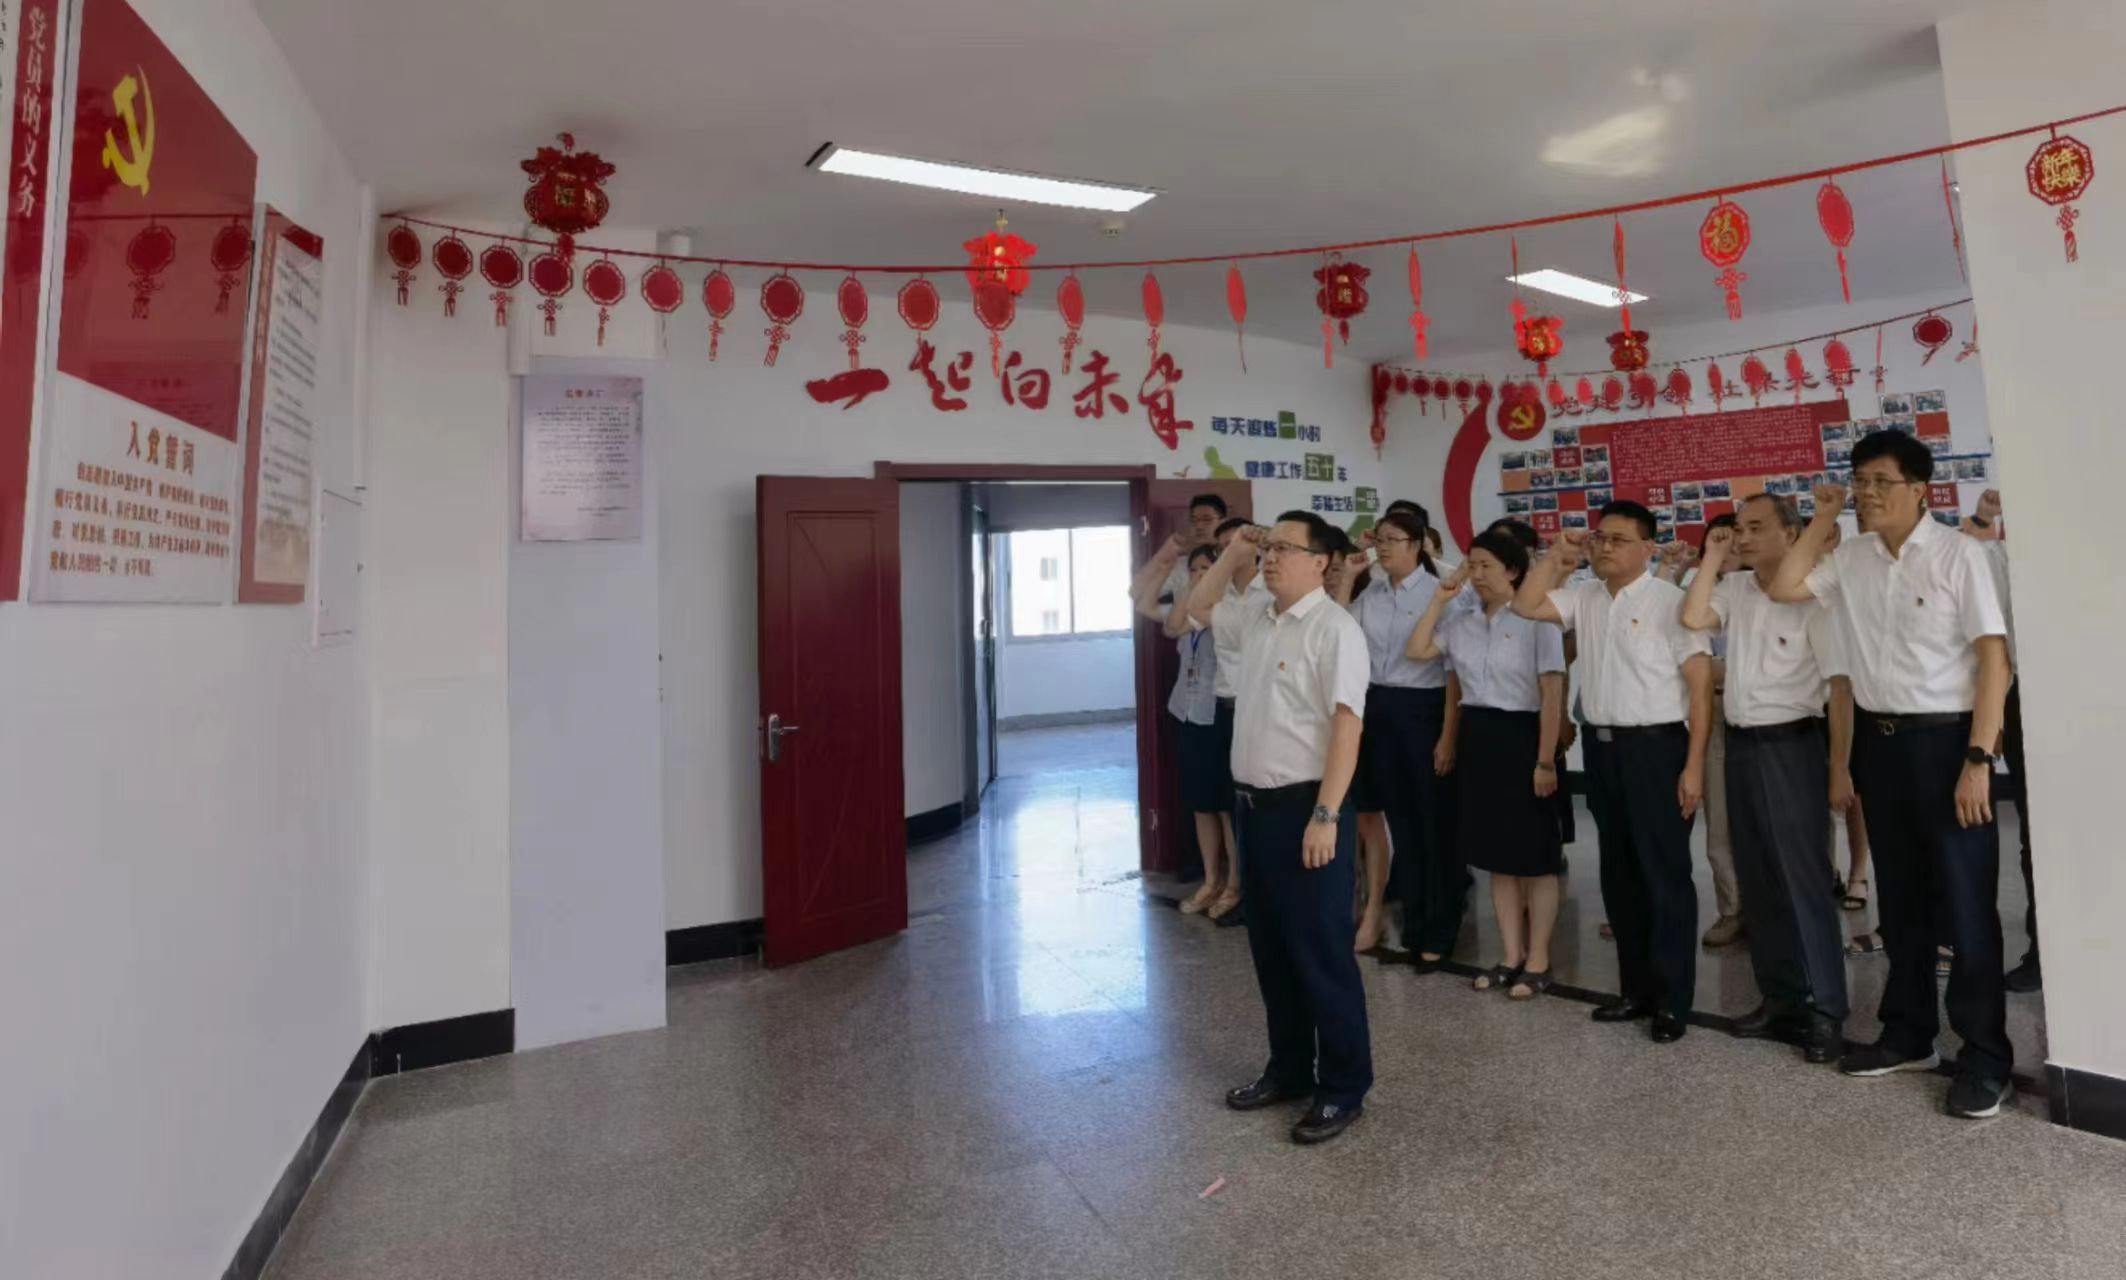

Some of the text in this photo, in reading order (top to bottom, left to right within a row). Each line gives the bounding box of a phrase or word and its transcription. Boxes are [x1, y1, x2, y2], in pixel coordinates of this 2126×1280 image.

[806, 340, 1194, 450] 一起向未来
